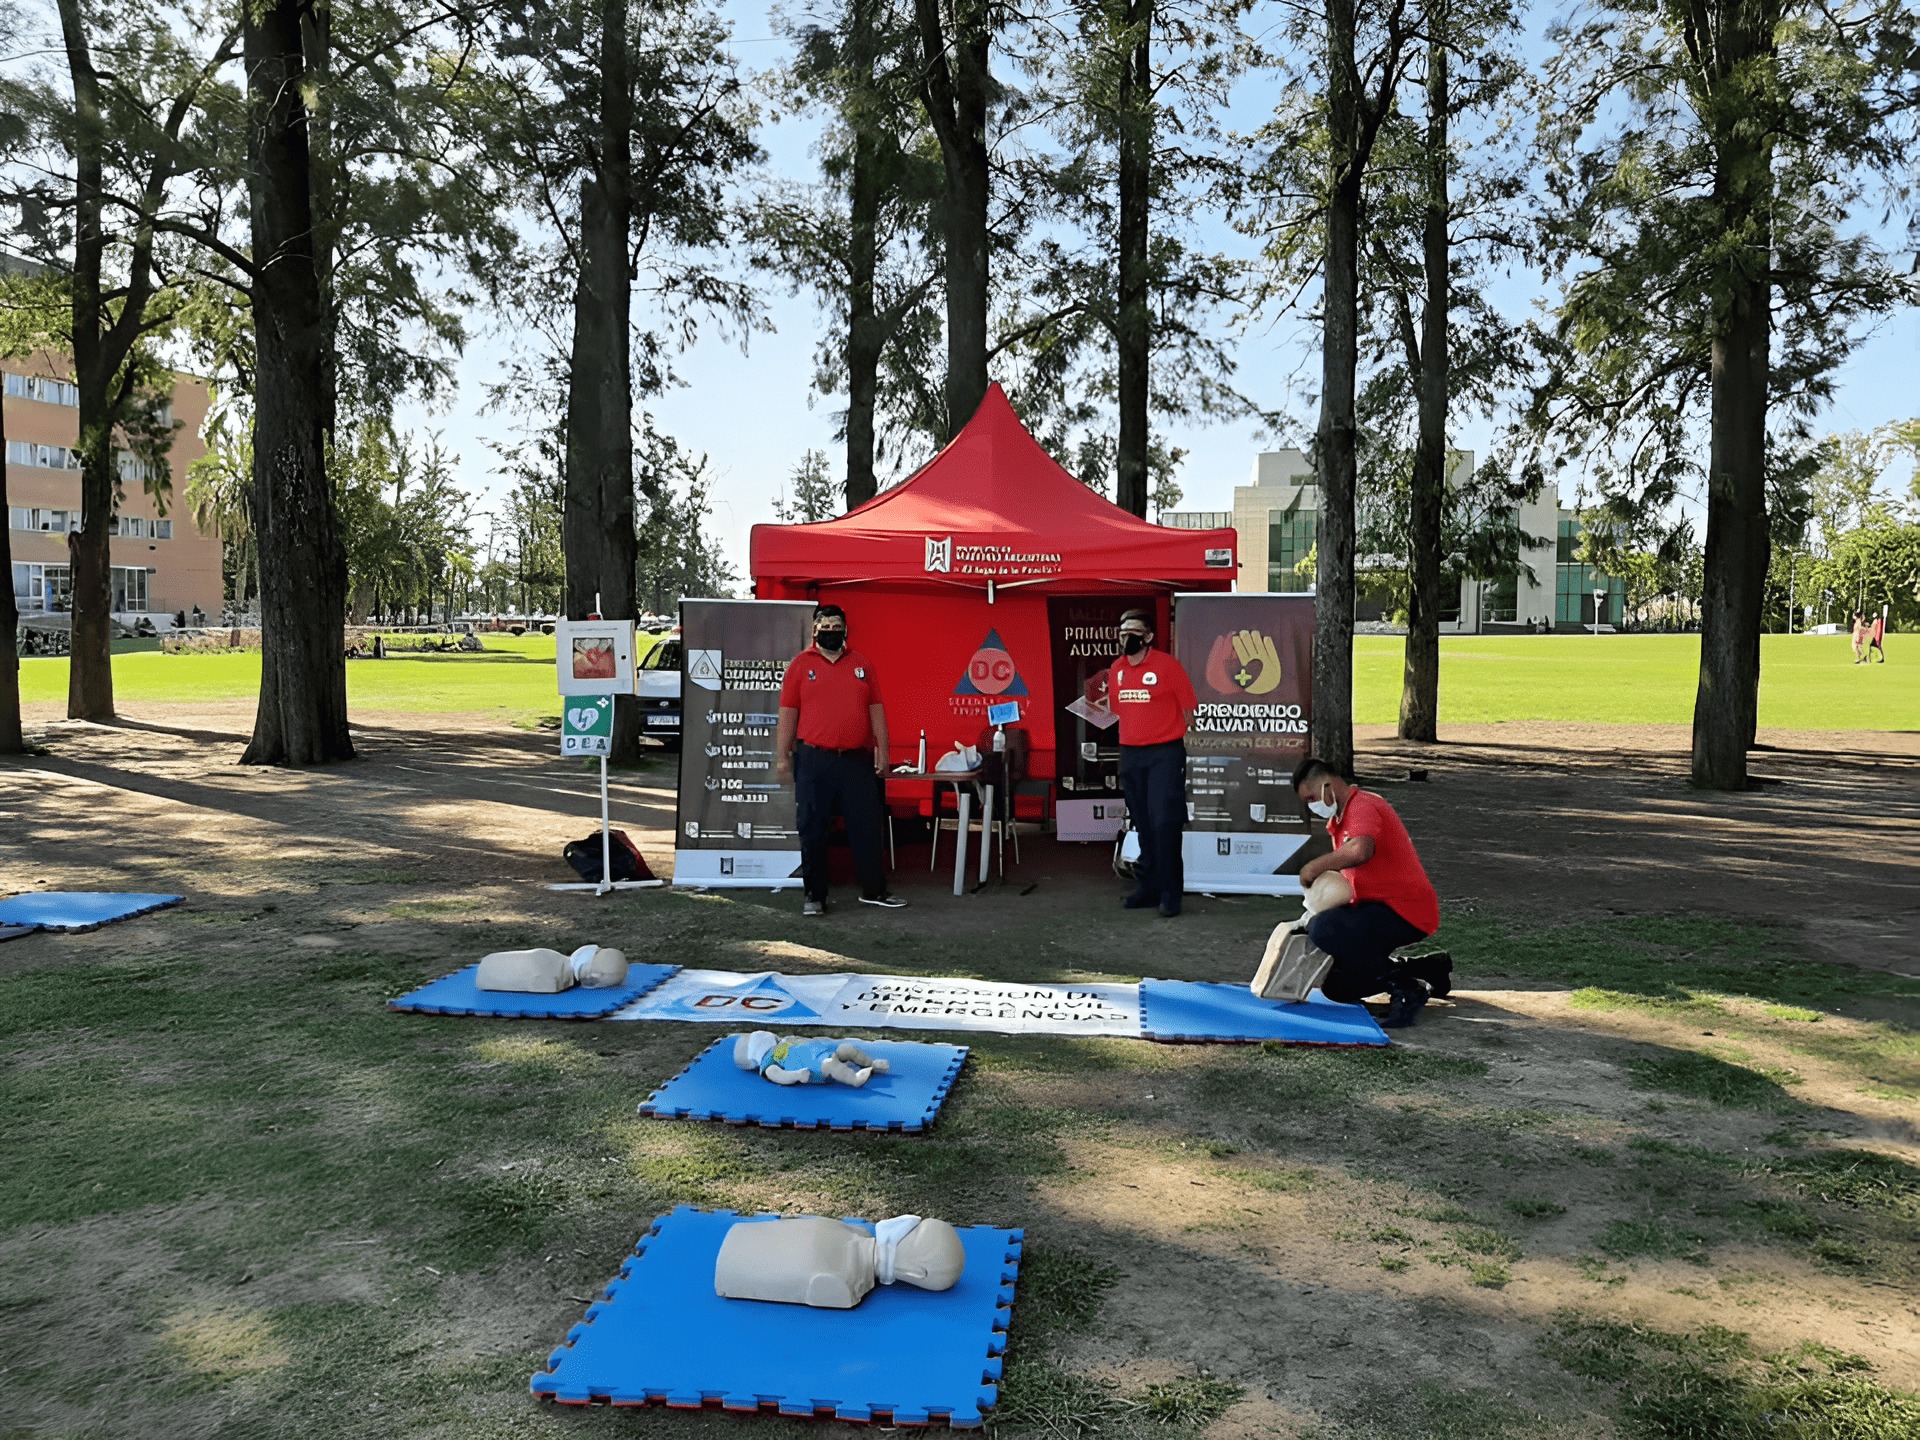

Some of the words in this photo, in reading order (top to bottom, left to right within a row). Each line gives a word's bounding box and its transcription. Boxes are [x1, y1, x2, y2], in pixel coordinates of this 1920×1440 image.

[971, 661, 1011, 681] DC
[1195, 718, 1255, 733] SALVAR
[1258, 718, 1309, 734] VIDAS
[566, 737, 607, 750] DEA
[693, 994, 784, 1011] DC
